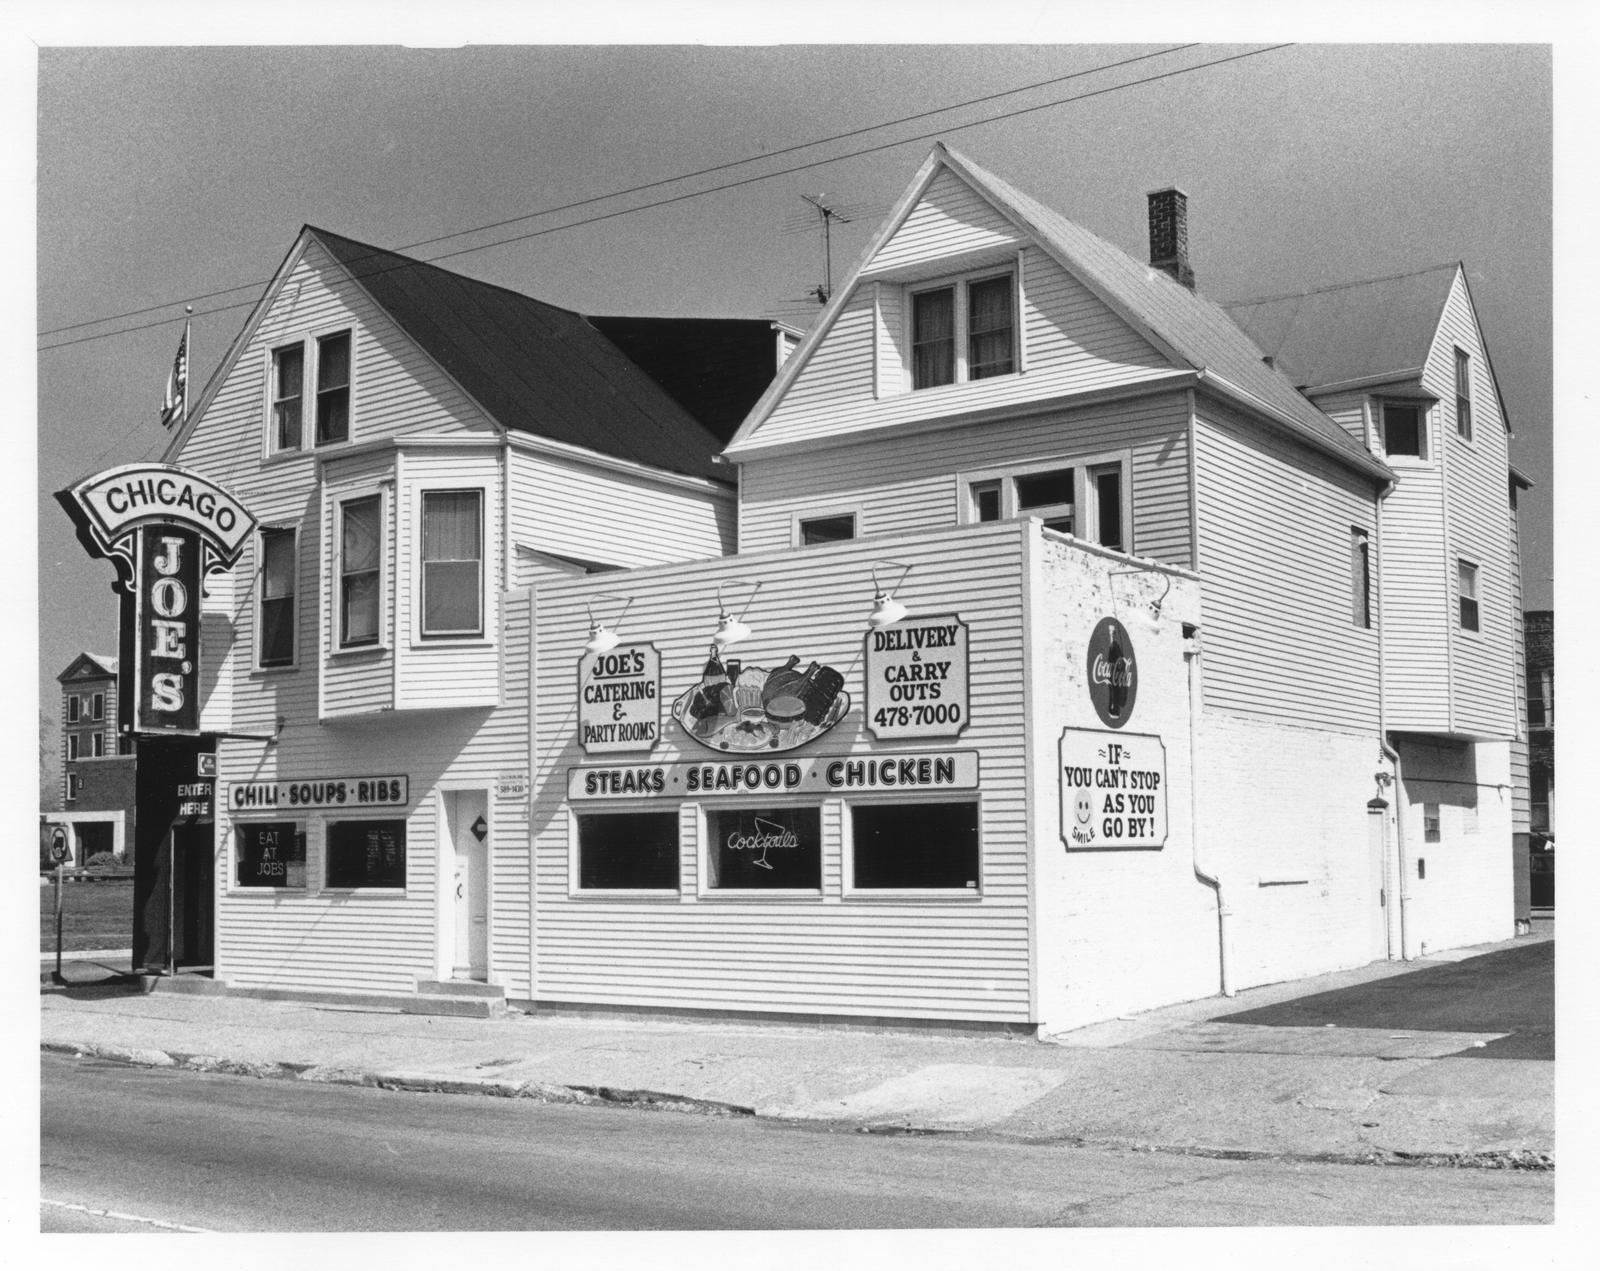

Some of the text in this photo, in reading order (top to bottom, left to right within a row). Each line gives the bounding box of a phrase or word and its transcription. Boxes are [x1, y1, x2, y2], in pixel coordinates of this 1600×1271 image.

[106, 478, 237, 533] CHICAGO
[151, 536, 193, 712] JOE'S
[874, 625, 959, 652] DELIVERY
[592, 648, 645, 676] JOE'S
[912, 650, 922, 662] &
[884, 661, 952, 683] CARRY
[584, 680, 656, 704] CATERING
[889, 682, 942, 702] OUTS
[613, 702, 627, 721] &
[584, 721, 656, 744] PARTY ROOMS
[1108, 743, 1123, 765] IF
[585, 757, 956, 795] STEAKS SEAFOOD CHICKEN
[1064, 766, 1161, 791] YOU CAN'T STOP
[177, 782, 213, 797] ENTER
[234, 779, 401, 807] CHILI SOUPS RIBS
[179, 801, 209, 816] HERE
[1102, 793, 1156, 815] AS YOU
[258, 831, 280, 845] EAT
[1071, 825, 1097, 845] SMILE
[1102, 816, 1124, 838] GO
[727, 830, 800, 850] Cocktails
[263, 847, 278, 861] AT
